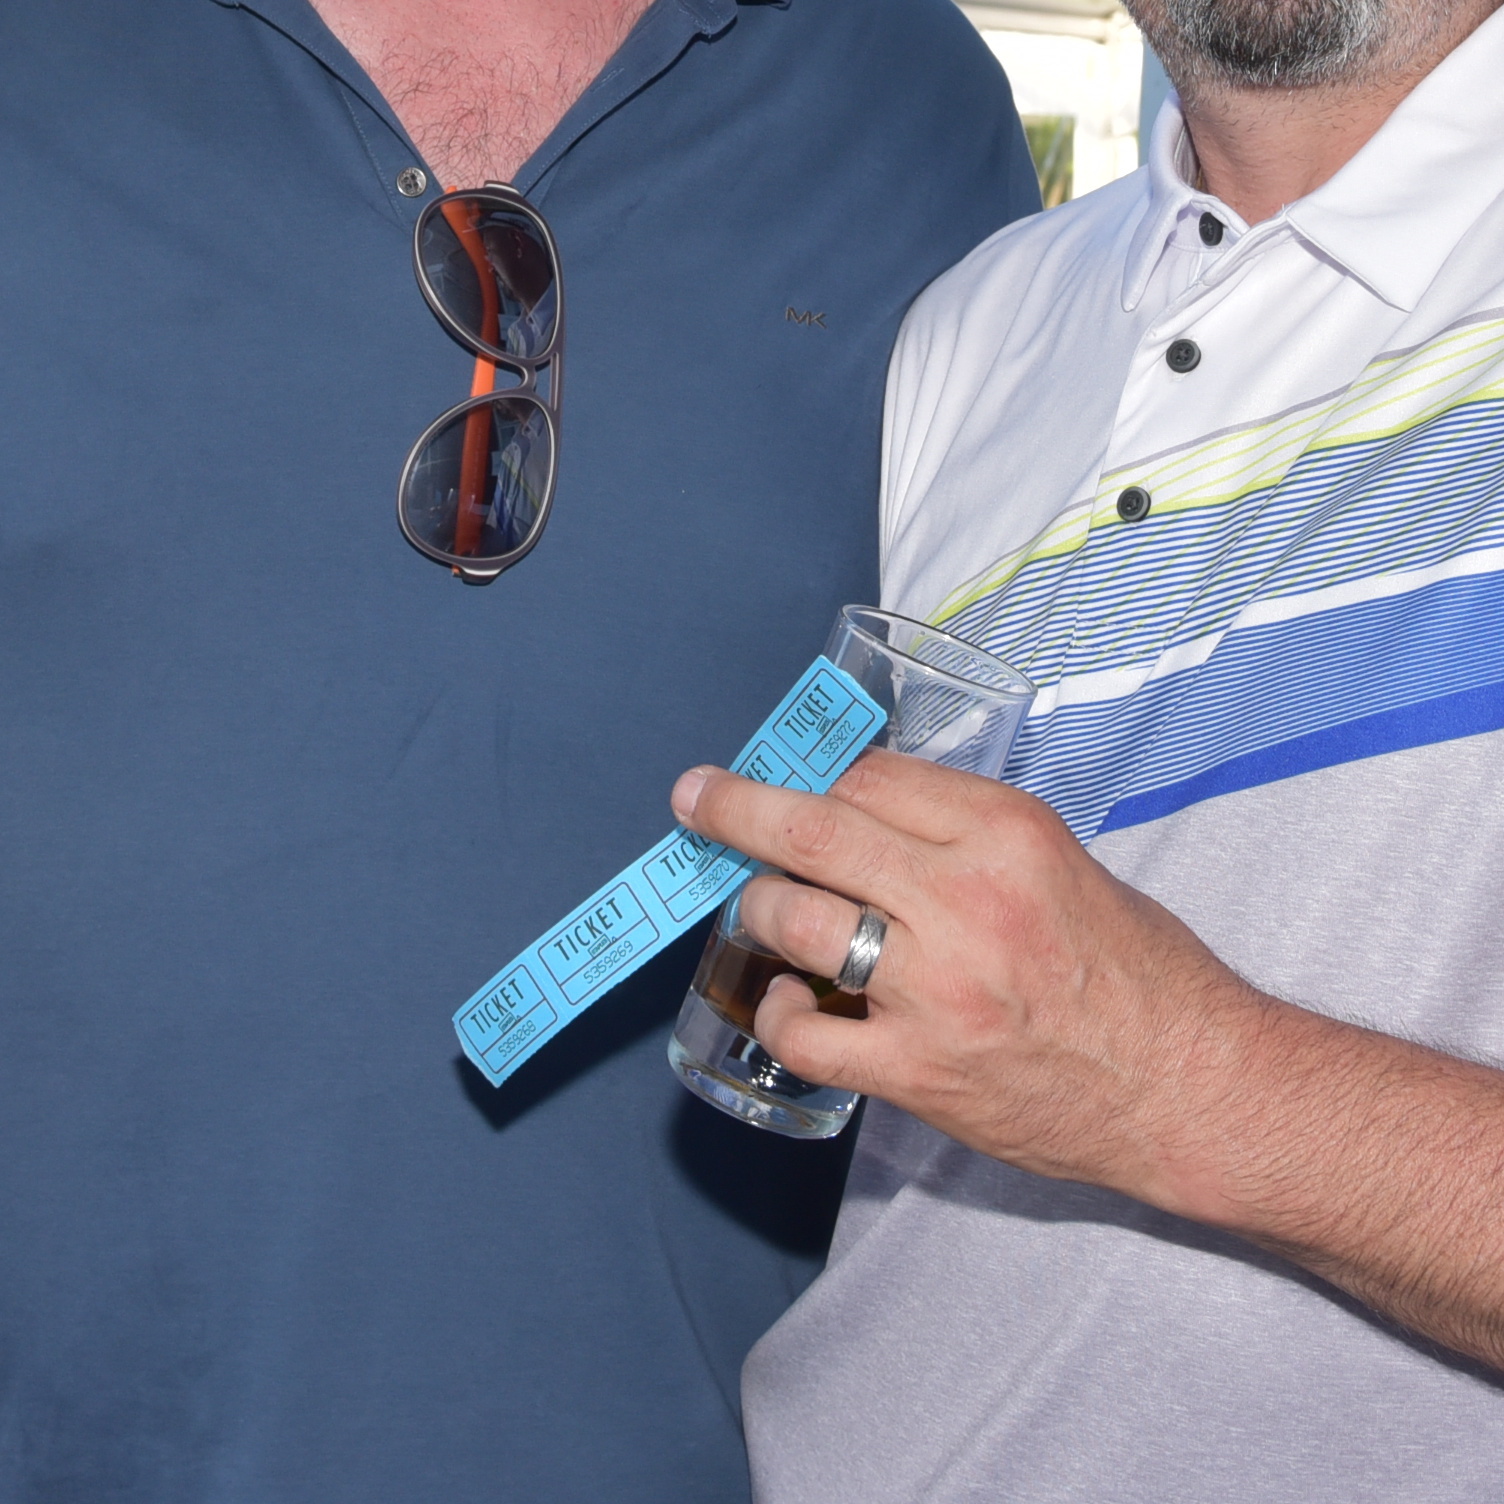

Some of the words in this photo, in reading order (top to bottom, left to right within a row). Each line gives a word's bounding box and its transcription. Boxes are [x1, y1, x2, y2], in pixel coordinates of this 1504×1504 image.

[784, 683, 834, 739] TICKET
[820, 719, 856, 759] 5359272
[688, 859, 730, 902] 5359270
[553, 897, 623, 962] TICKET
[583, 939, 634, 985] 5359269
[470, 978, 525, 1035] TICKET
[497, 1019, 537, 1058] 5359268
